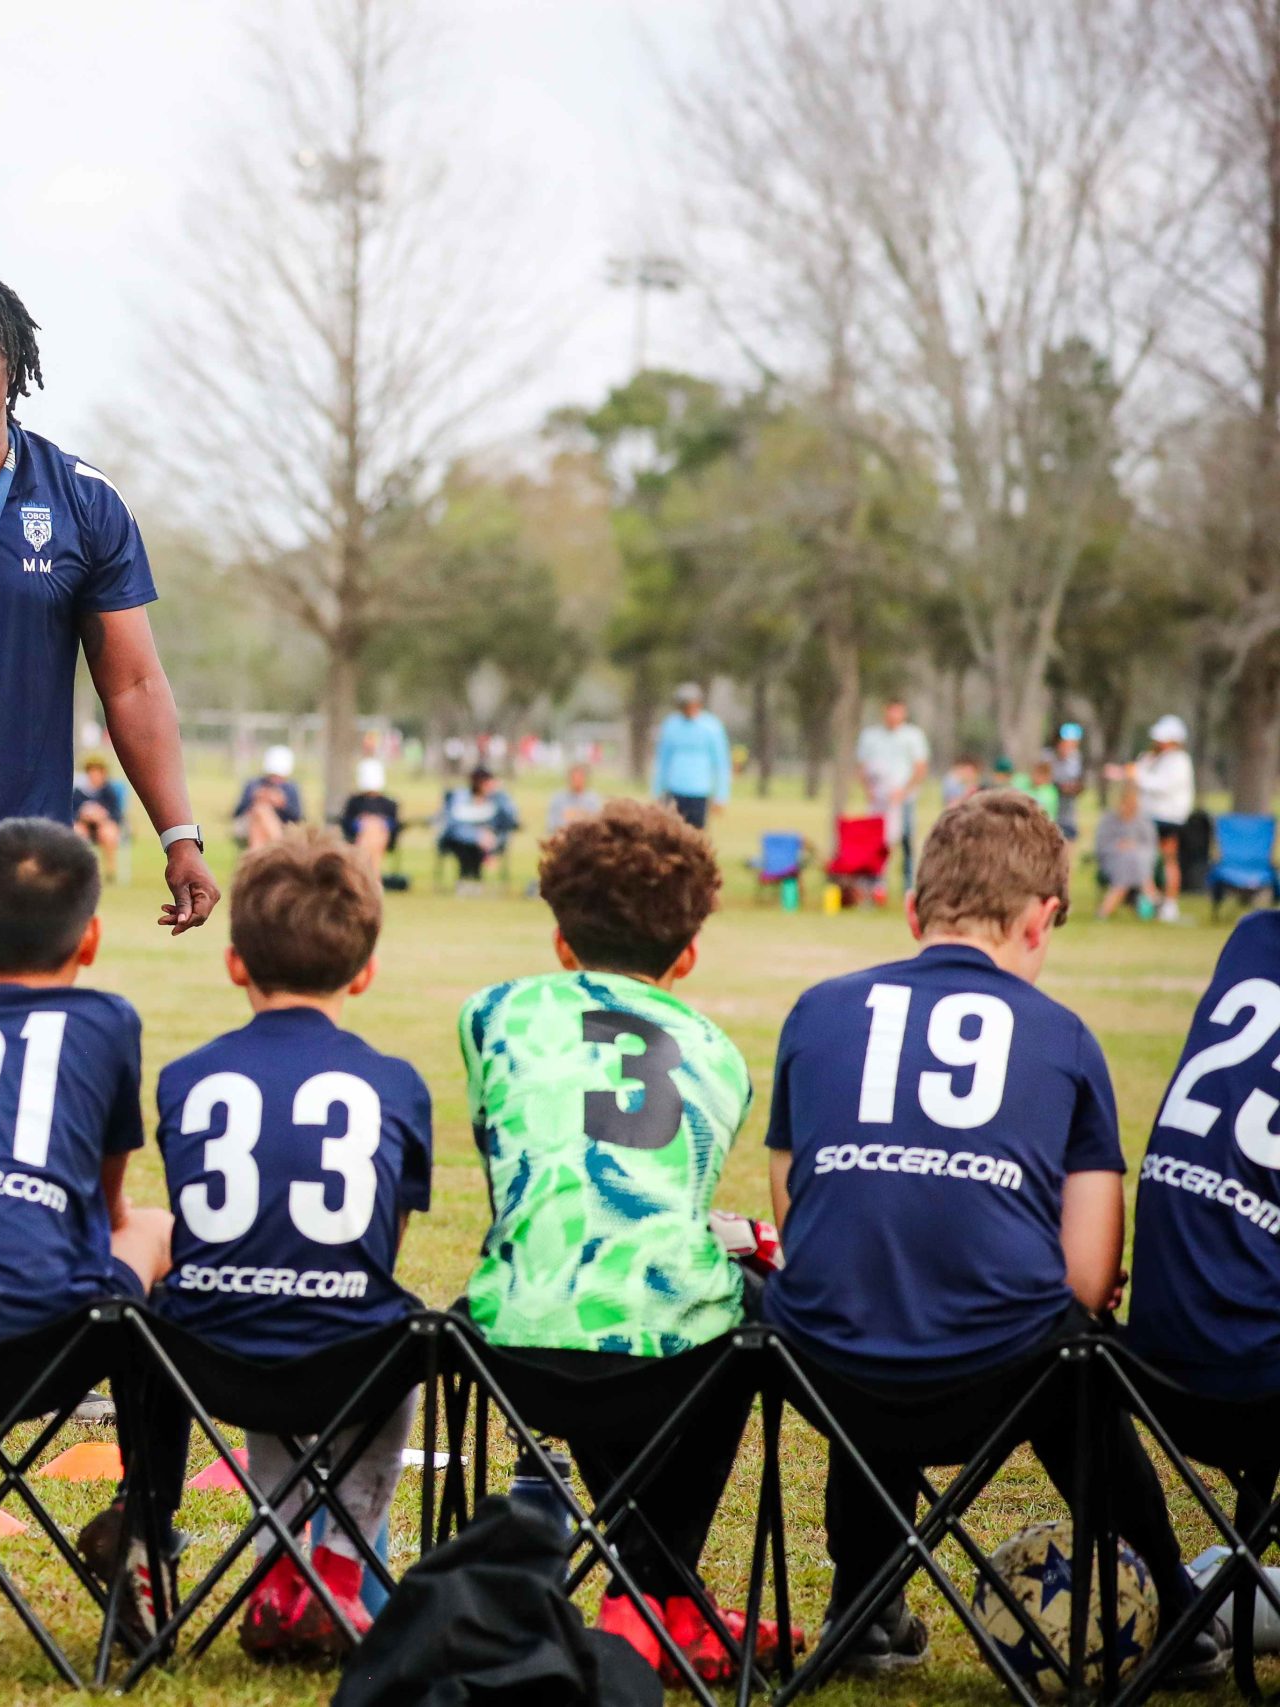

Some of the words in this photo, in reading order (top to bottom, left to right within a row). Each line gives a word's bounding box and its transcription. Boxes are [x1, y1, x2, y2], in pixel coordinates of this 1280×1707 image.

[22, 512, 51, 520] LOBOS
[581, 1009, 683, 1150] 3
[858, 983, 1015, 1129] 19
[179, 1071, 382, 1245] 33
[814, 1143, 1023, 1191] SOCCER.COM
[179, 1263, 369, 1299] SOCCER.COM
